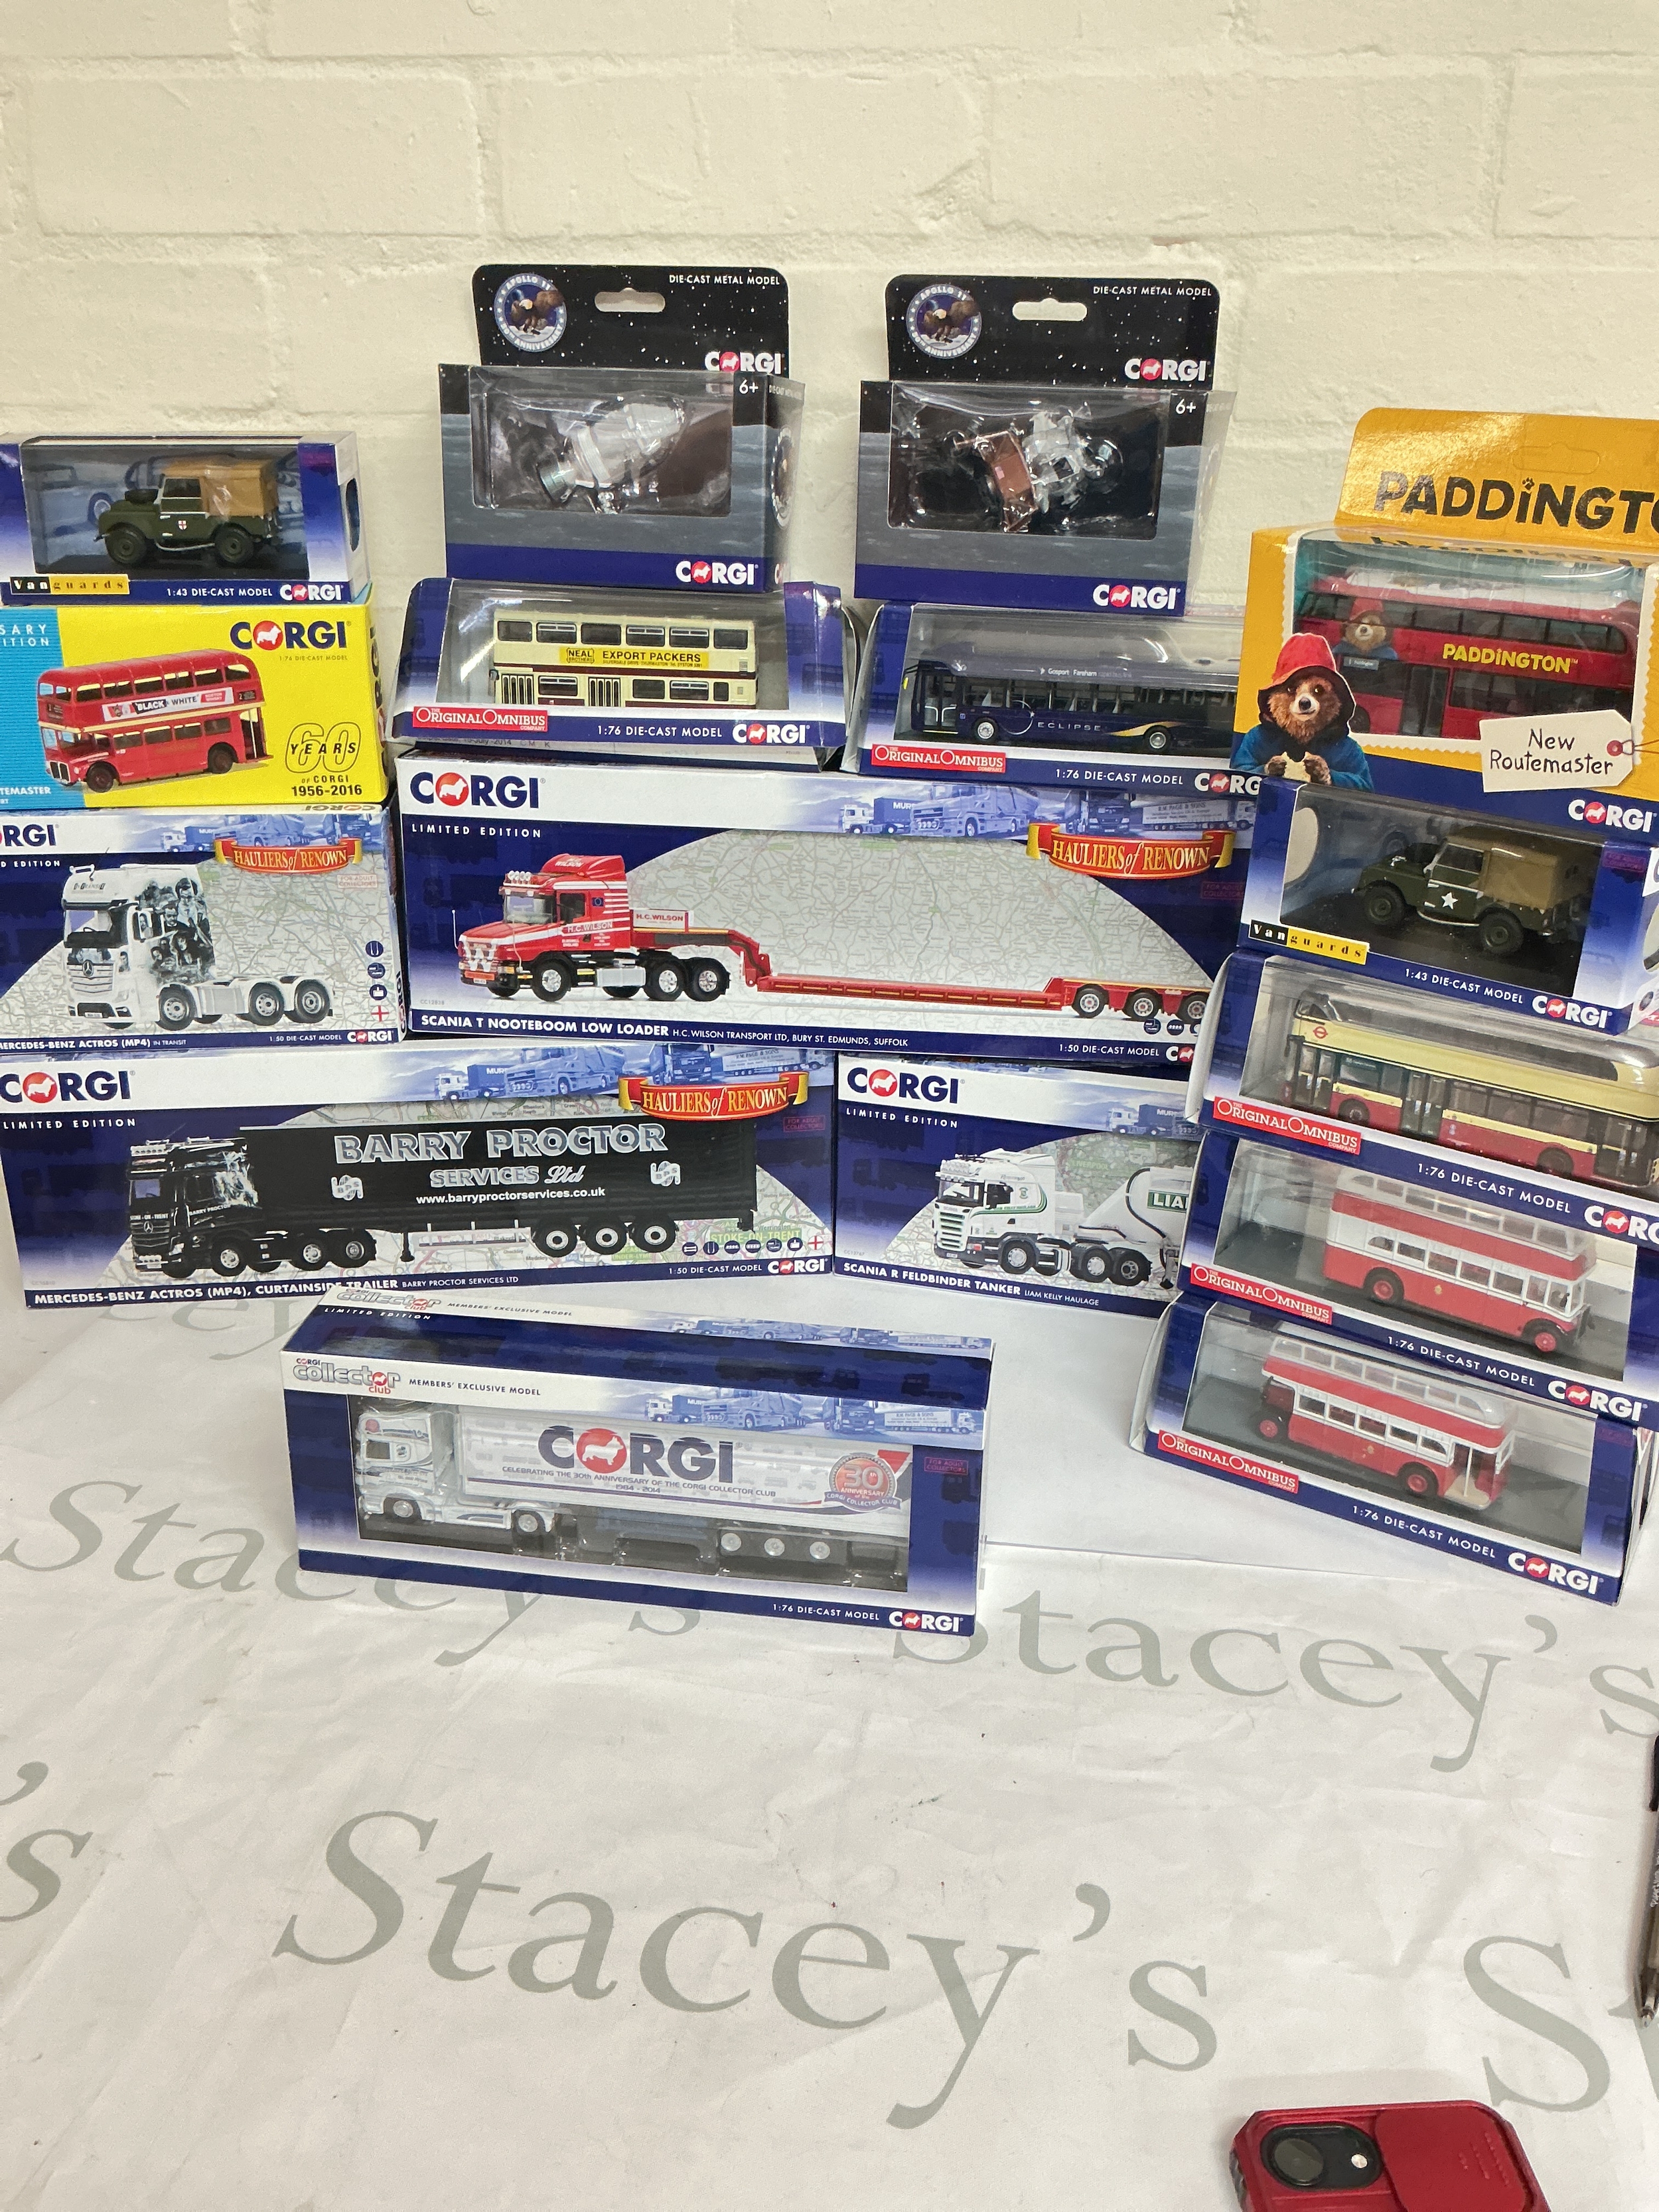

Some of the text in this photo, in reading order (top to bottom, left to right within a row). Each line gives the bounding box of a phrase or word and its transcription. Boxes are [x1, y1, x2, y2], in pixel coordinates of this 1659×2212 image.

[669, 275, 780, 285] DIE-CAST METAL MODEL
[1093, 286, 1212, 296] DIE-CAST METAL MODEL
[705, 351, 781, 374] CORGI
[1124, 358, 1206, 382] CORGI
[739, 379, 758, 394] 6+
[1175, 399, 1196, 414] 6+
[676, 560, 755, 585] CORGI
[167, 588, 273, 597] 1:43 DIE-CAST MODEL
[279, 584, 342, 601] CORGI
[1093, 584, 1176, 609] CORGI
[230, 620, 346, 651] CORGI
[603, 650, 646, 660] EXPORT
[650, 652, 701, 662] PACKERS
[598, 725, 722, 737] 1:76 DIE-CAST MODEL
[733, 723, 806, 744] CORGI
[1038, 721, 1101, 731] ECLIPSE
[291, 742, 356, 755] YEARS
[1528, 728, 1575, 751] New
[1490, 749, 1613, 775] Routemaster
[313, 774, 349, 783] CORGI
[1056, 769, 1183, 784] 1:76 DIE-CAST MODEL
[291, 784, 362, 796] 1956-2016
[410, 771, 539, 808] CORGI
[1568, 799, 1653, 833] CORGI
[412, 824, 541, 838] LIMITED EDITION
[234, 848, 346, 871] HAULIERS of RENOWN
[1052, 840, 1210, 874] HAULIERS of RENOWN
[1405, 968, 1523, 1004] 1:43 DIE-CAST MODEL
[1532, 995, 1607, 1028] CORGI
[347, 1031, 392, 1043] CORGI
[421, 1015, 472, 1027] SCANIA
[476, 1017, 484, 1027] T
[488, 1018, 577, 1032] NOOTEBOOM
[581, 1022, 612, 1033] LOW
[617, 1024, 669, 1036] LOADER
[726, 1031, 772, 1041] TRANSPORT
[775, 1034, 790, 1043] LTD,
[828, 1036, 871, 1045] EDMUNDS,
[874, 1038, 908, 1047] SUFFOLK
[79, 1039, 118, 1048] ACTROS
[121, 1038, 151, 1048] (MP4)
[1060, 1044, 1079, 1053] 1:50
[1082, 1045, 1124, 1055] DIE-CAST
[1127, 1047, 1159, 1056] MODEL
[0, 1070, 131, 1103] CORGI
[847, 1067, 959, 1104] CORGI
[643, 1086, 788, 1117] HAULIERS of RENOWN
[3, 1118, 136, 1130] LIMITED EDITION
[846, 1108, 958, 1128] LIMITED EDITION
[334, 1124, 670, 1164] BARRY PROCTOR
[1328, 1141, 1356, 1154] COMPANY
[430, 1165, 585, 1188] SERVICES Ltd
[416, 1187, 605, 1205] www.barryproctorservices.co.uk
[1417, 1163, 1571, 1213] 1:76 DIE-CAST MODEL
[711, 1230, 801, 1244] STOKE-ON-TRENT
[690, 1265, 729, 1274] DIE-CAST
[767, 1259, 825, 1274] CORGI
[35, 1291, 145, 1305] MERCEDES-BENZ
[150, 1288, 204, 1299] ACTROS
[207, 1286, 251, 1298] (MP4),
[346, 1280, 399, 1290] TRAILER
[429, 1278, 466, 1287] PROCTOR
[843, 1262, 1100, 1306] SCANIA R FELDBINDER TANKER LIAM KELLY HAULAGE
[336, 1291, 441, 1308] collector
[324, 1307, 431, 1321] LIMITED EDITION
[1387, 1336, 1534, 1386] 1:76 DIE-CAST MODEL
[293, 1363, 401, 1388] collector
[368, 1385, 392, 1394] club
[409, 1378, 541, 1396] MEMBERS' EXCLUSIVE MODEL
[1548, 1380, 1642, 1423] CORGI
[538, 1425, 733, 1483] CORGI
[502, 1466, 555, 1477] CELEBRATING
[594, 1474, 649, 1485] ANNIVERSARY
[709, 1485, 753, 1495] COLLECTOR
[840, 1487, 885, 1497] ANNIVERSARY
[846, 1497, 880, 1507] COLLECTOR
[1352, 1505, 1496, 1559] 1:76 DIE-CAST MODEL
[1508, 1551, 1598, 1595] CORGI
[772, 1603, 879, 1621] 1:76 DIE-CAST MODEL
[889, 1611, 960, 1633] CORGI
[273, 1810, 1219, 2130] Stacey's
